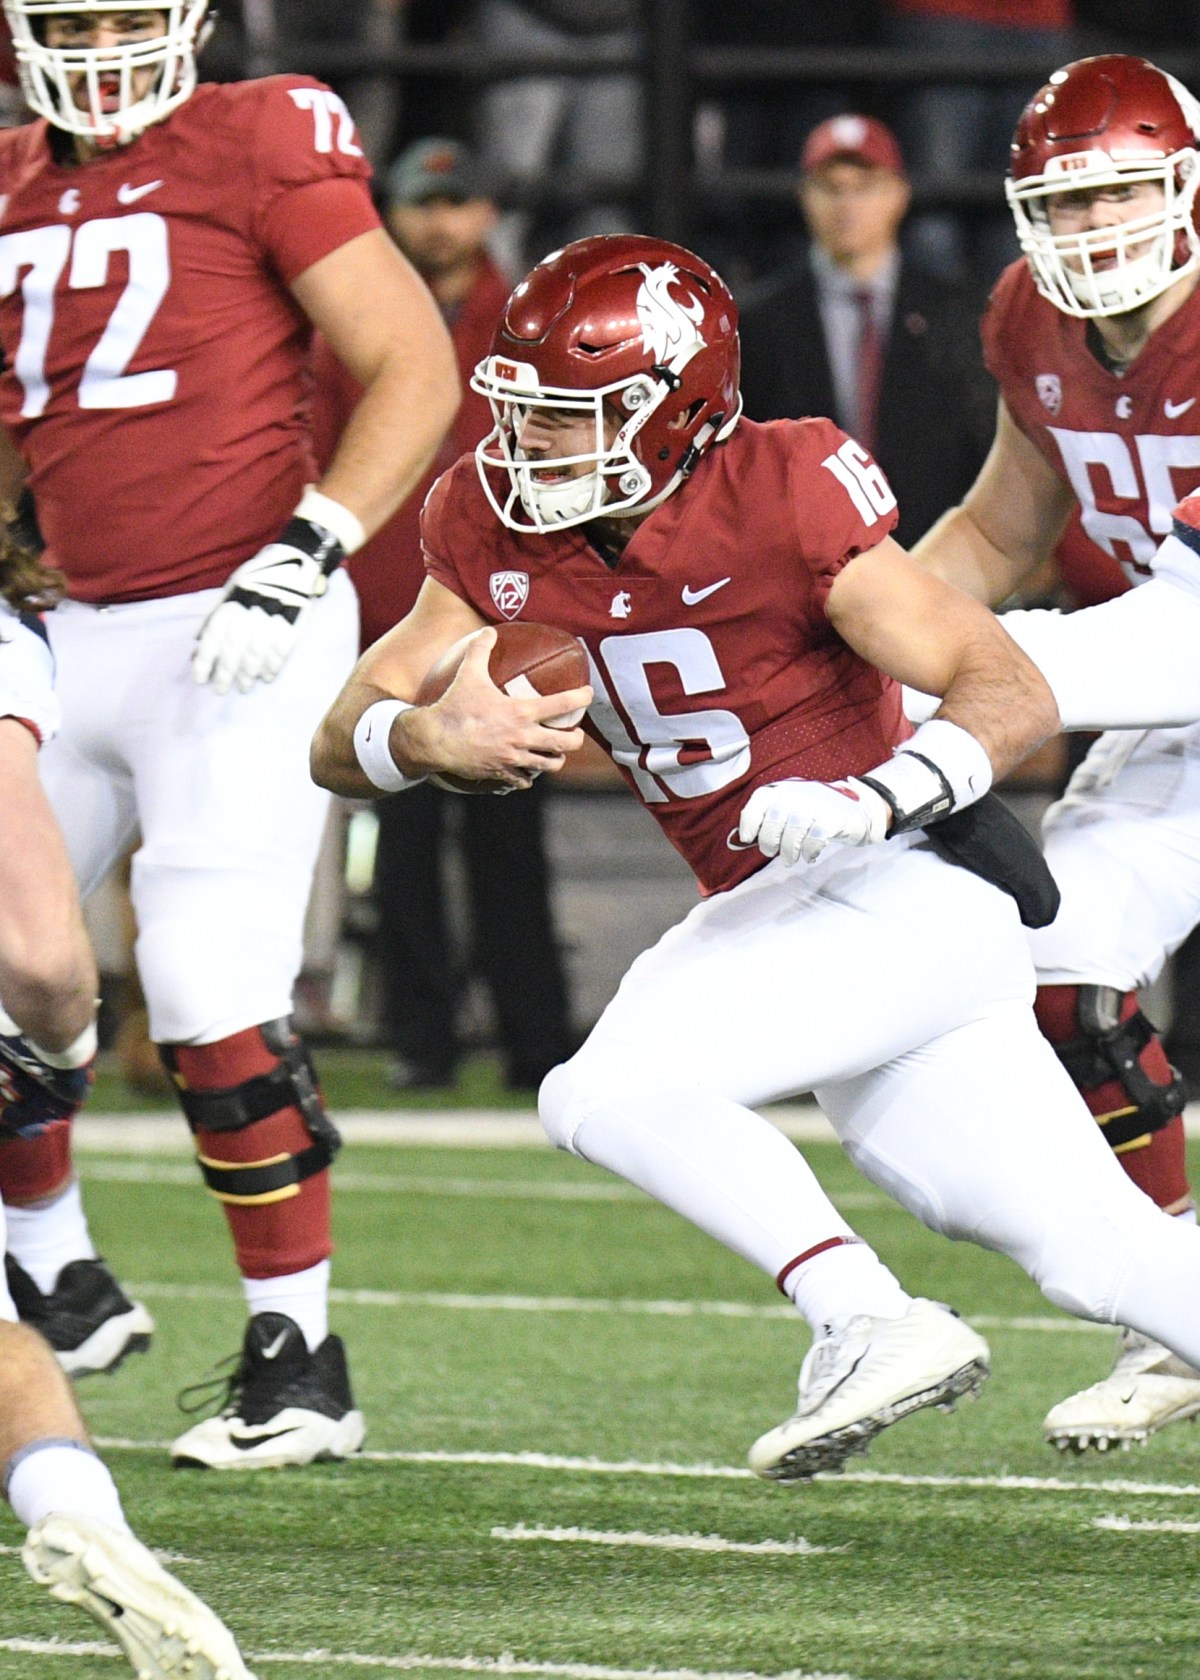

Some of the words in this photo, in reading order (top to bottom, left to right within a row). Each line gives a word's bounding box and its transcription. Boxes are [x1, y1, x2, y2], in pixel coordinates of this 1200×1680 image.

[287, 87, 364, 157] 72
[0, 212, 178, 419] 72
[820, 438, 898, 528] 16
[492, 572, 527, 602] PAC
[500, 591, 520, 610] 12
[577, 626, 751, 803] 16
